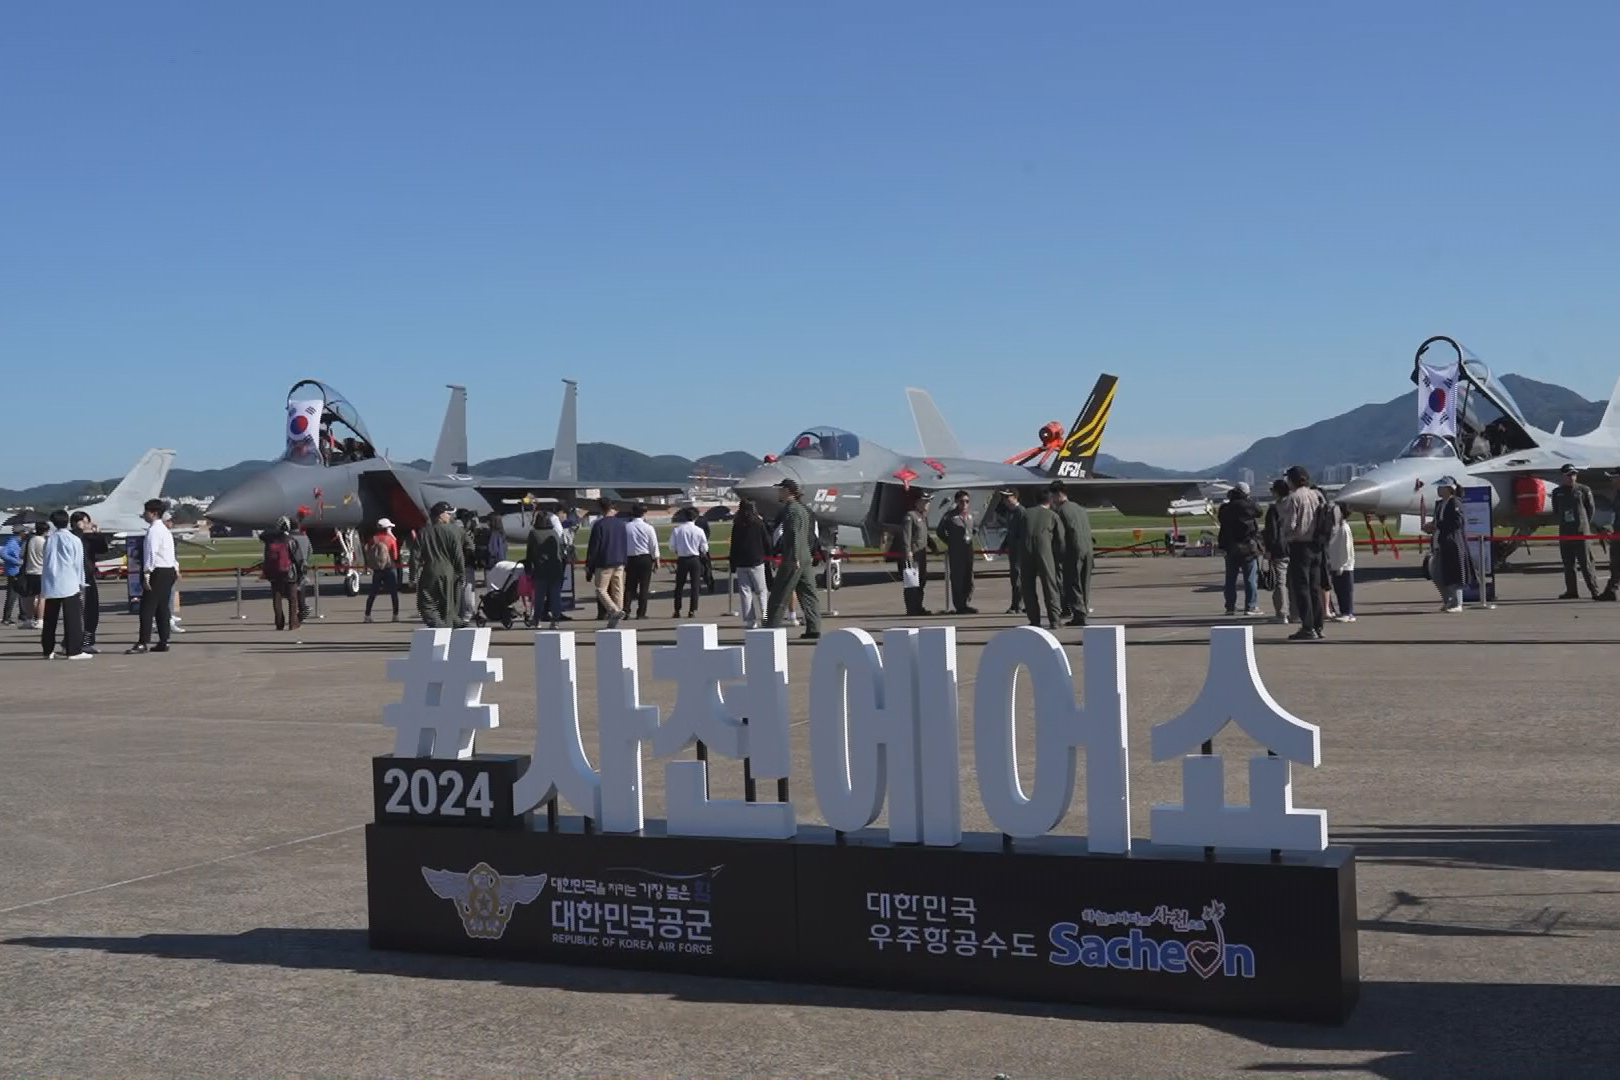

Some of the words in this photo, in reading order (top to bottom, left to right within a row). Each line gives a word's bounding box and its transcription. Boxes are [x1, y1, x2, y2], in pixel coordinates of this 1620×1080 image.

[384, 768, 494, 818] 2024
[550, 876, 606, 896] 대한민국을
[551, 899, 712, 942] 대한민국공군
[866, 891, 978, 925] 대한민국
[552, 933, 599, 947] REPUBLIC
[602, 937, 616, 947] OF
[618, 938, 655, 951] KOREA
[657, 941, 676, 952] AIR
[678, 943, 713, 955] FORCE
[867, 923, 1038, 959] 우주항공수도
[1048, 921, 1256, 979] Sacheon
